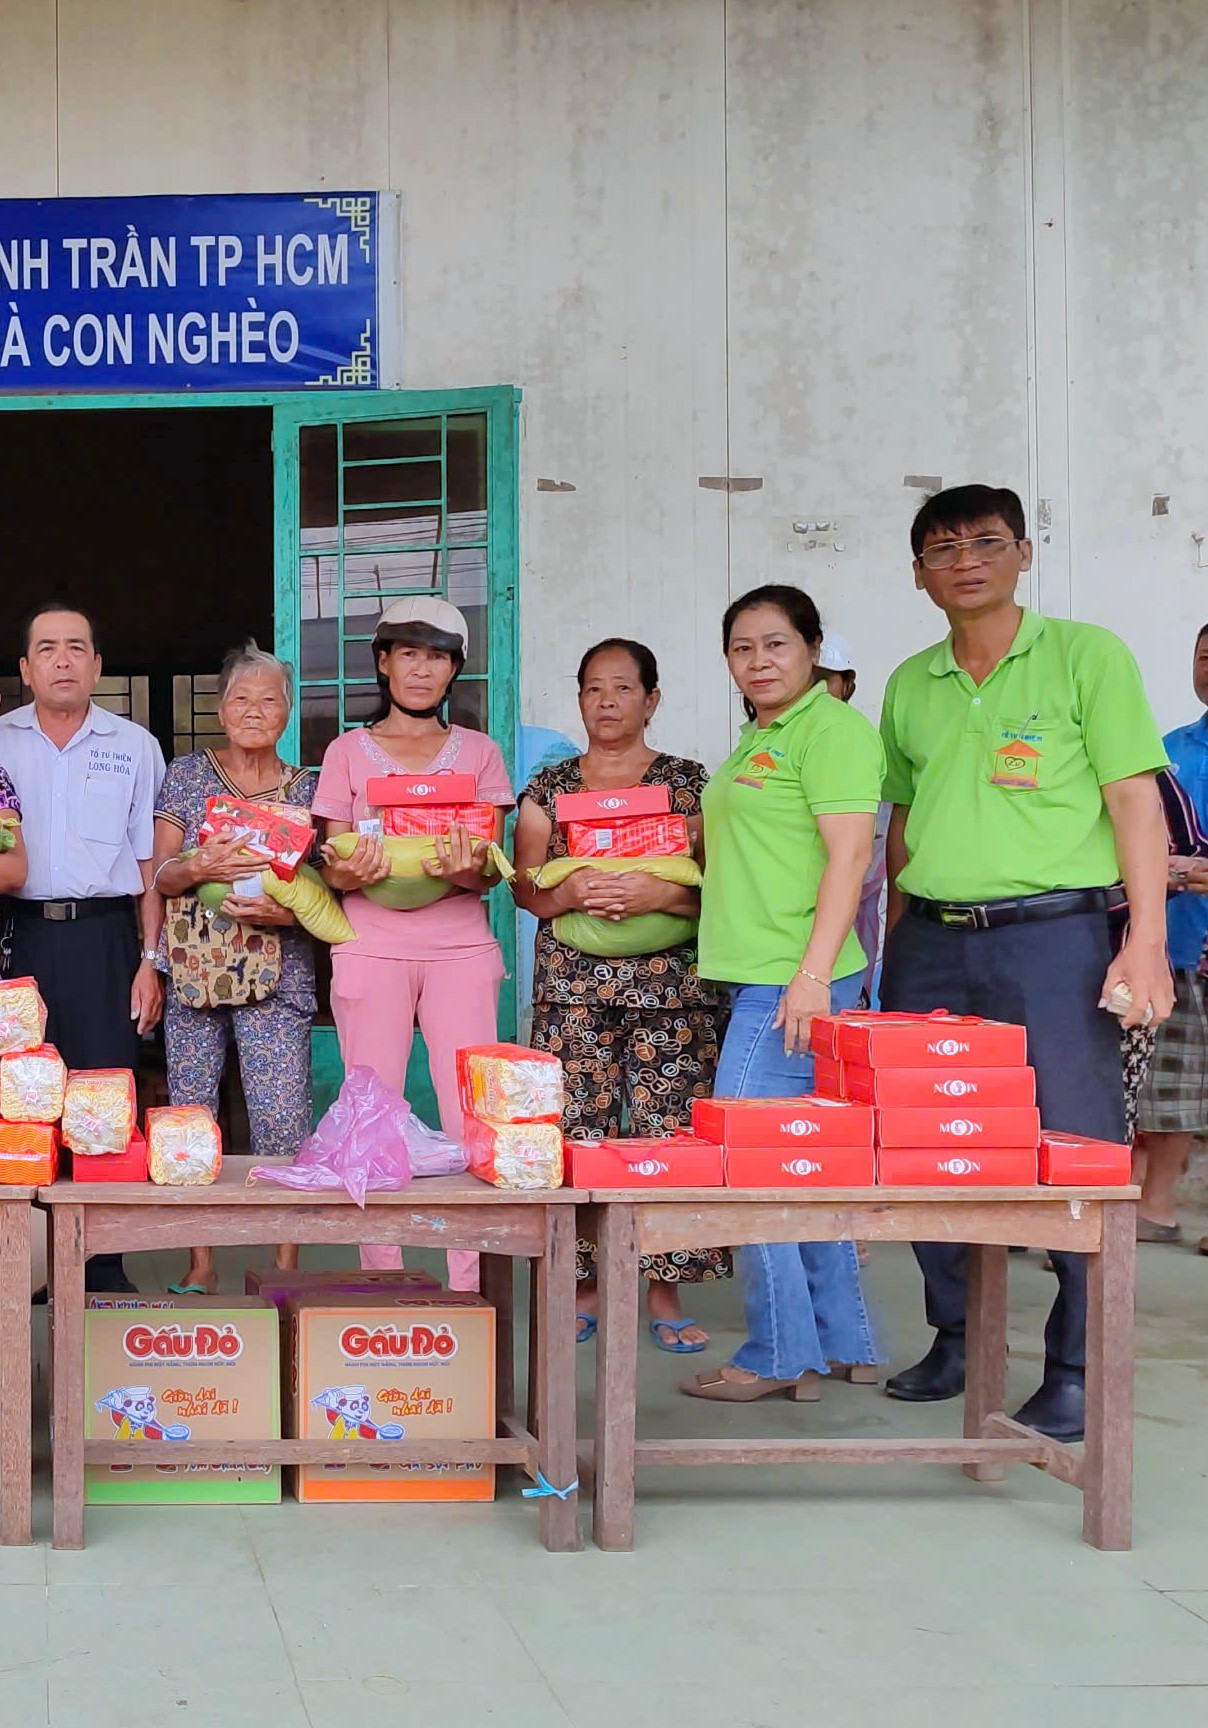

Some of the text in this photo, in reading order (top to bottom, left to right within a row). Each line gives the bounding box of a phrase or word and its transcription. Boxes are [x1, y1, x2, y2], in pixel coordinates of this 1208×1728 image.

[62, 225, 178, 290] TRẦN
[191, 234, 243, 287] TP
[256, 232, 350, 287] HCM
[43, 311, 133, 367] CON
[148, 297, 299, 366] NGHÈO
[125, 1324, 240, 1358] Gấu Đỏ
[341, 1324, 456, 1358] Gấu Đỏ
[161, 1387, 191, 1404] Giòn
[376, 1387, 406, 1404] Giòn
